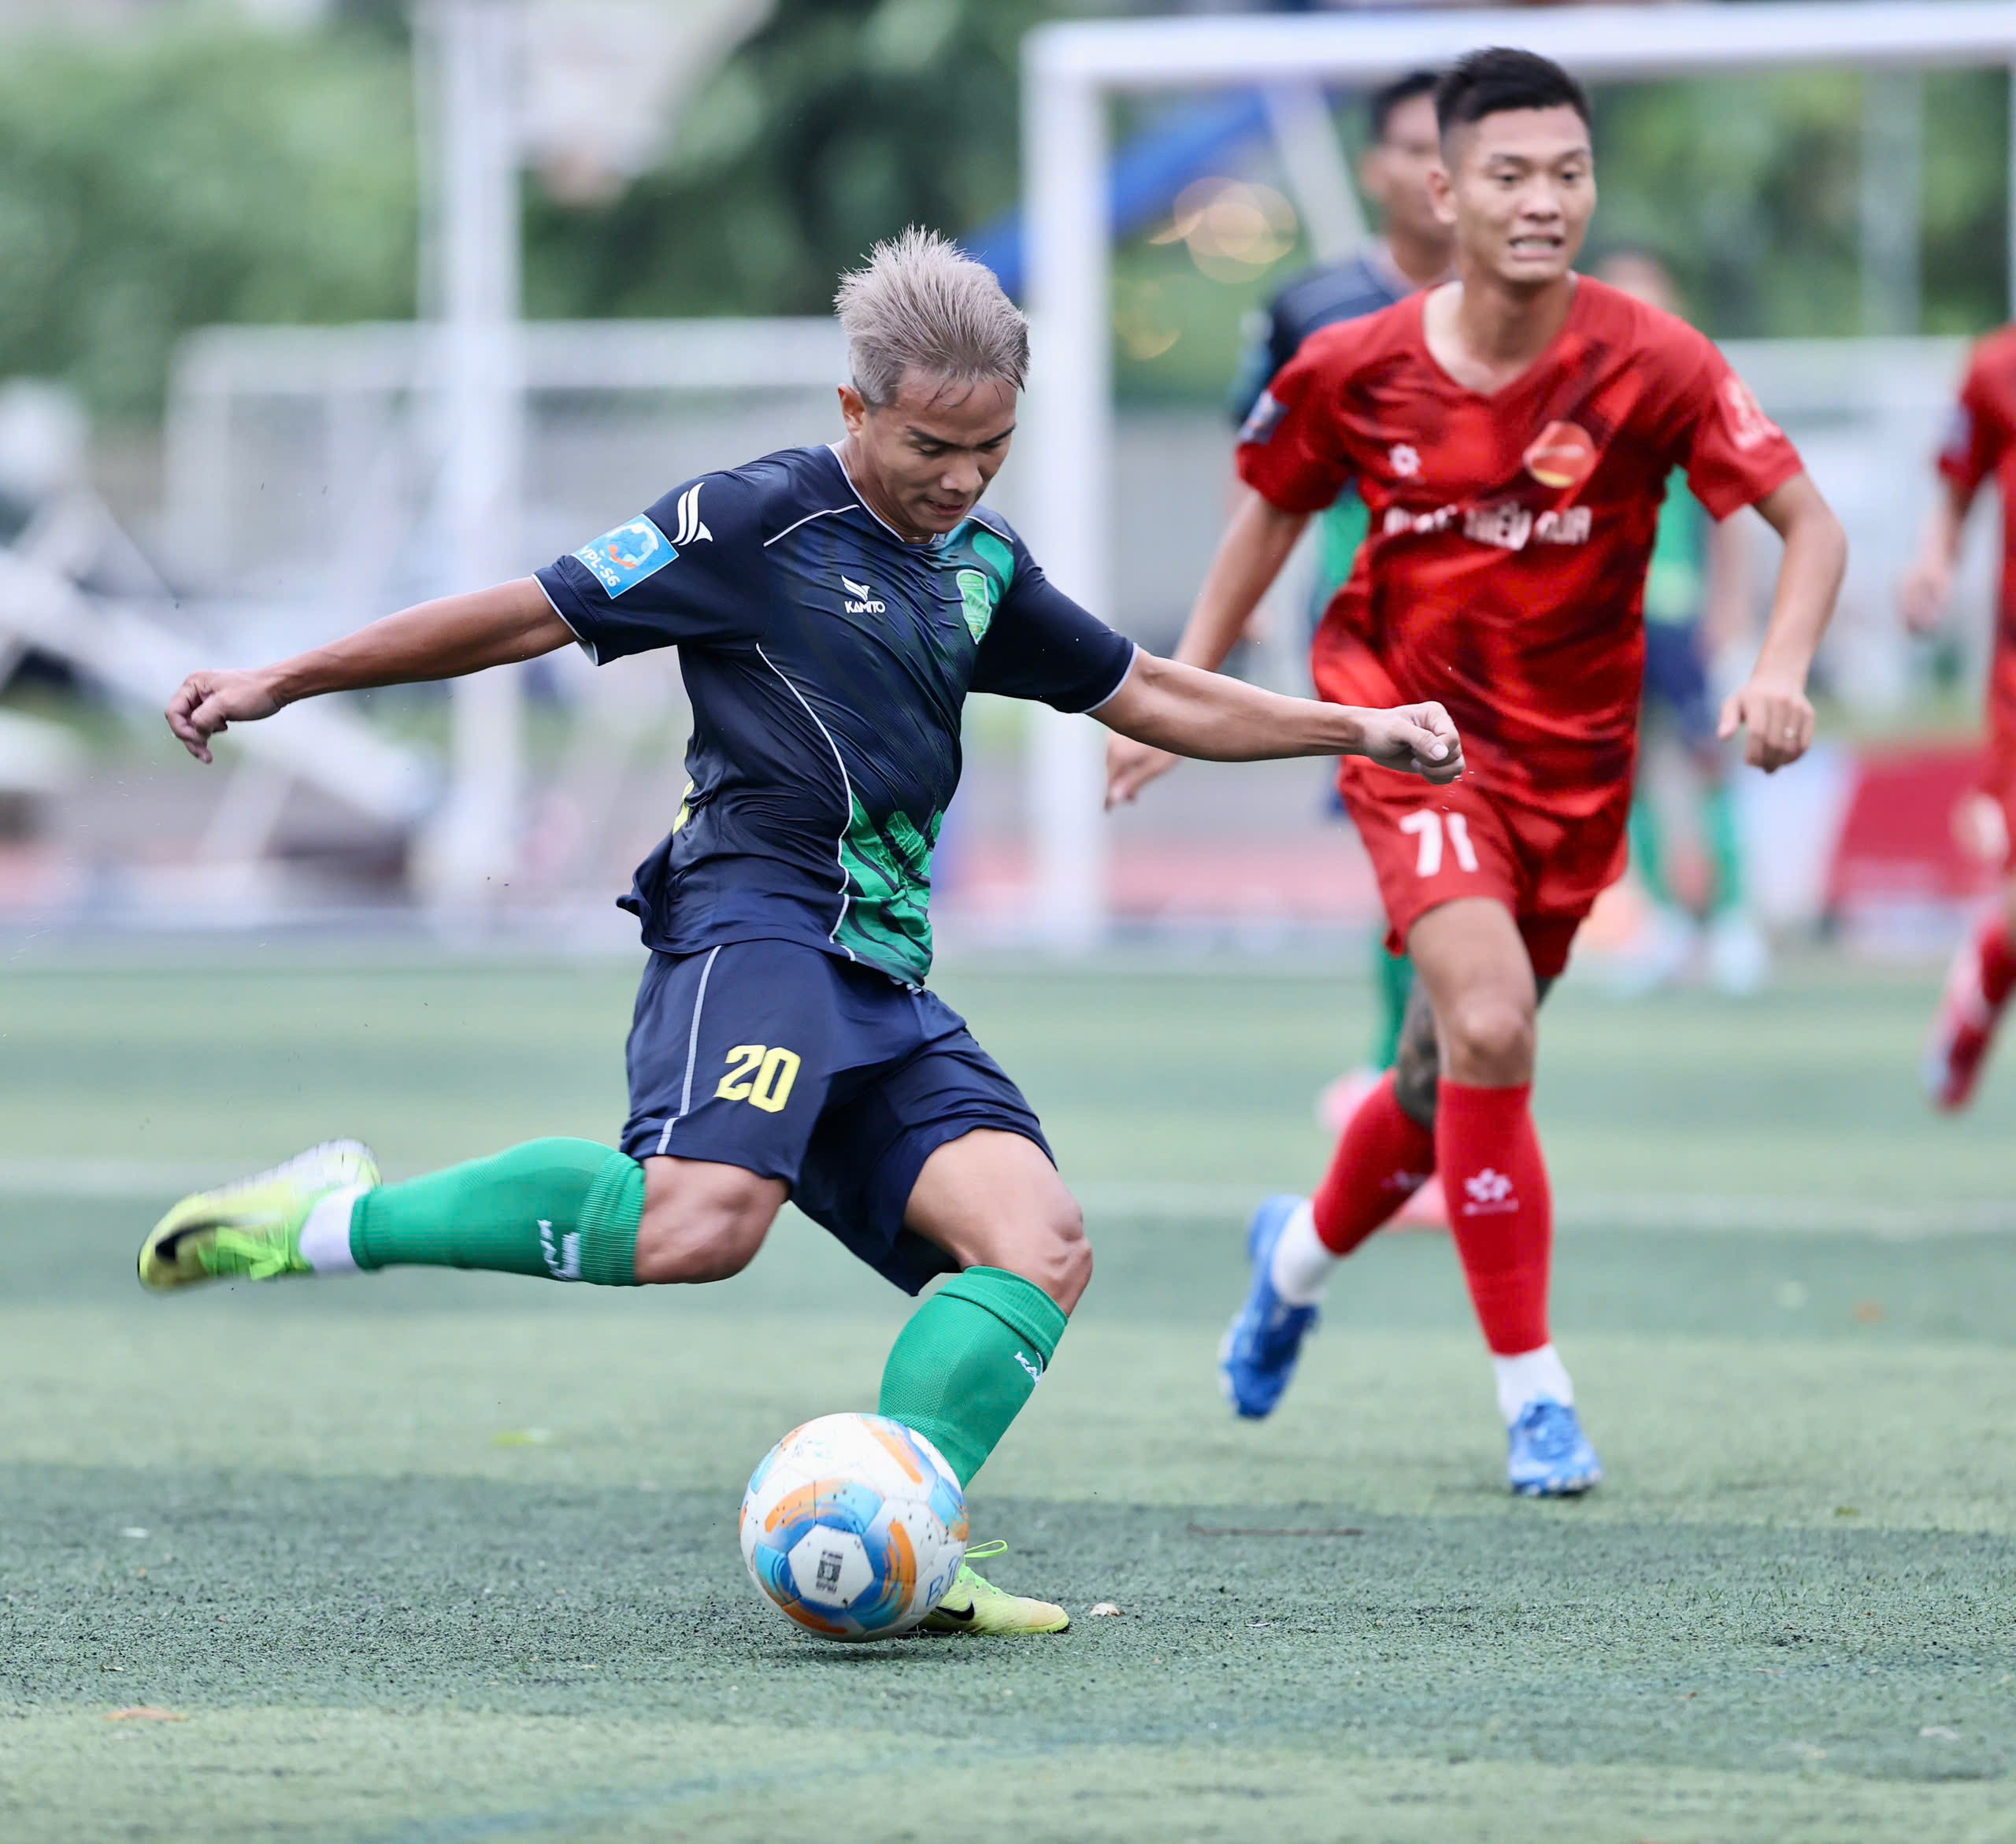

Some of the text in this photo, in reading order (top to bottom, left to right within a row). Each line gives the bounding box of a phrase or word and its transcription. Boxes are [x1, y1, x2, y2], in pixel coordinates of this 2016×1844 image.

[580, 546, 622, 588] VPL-S6
[843, 600, 887, 614] KAMITO
[1398, 808, 1480, 877] 71
[712, 1044, 802, 1113] 20
